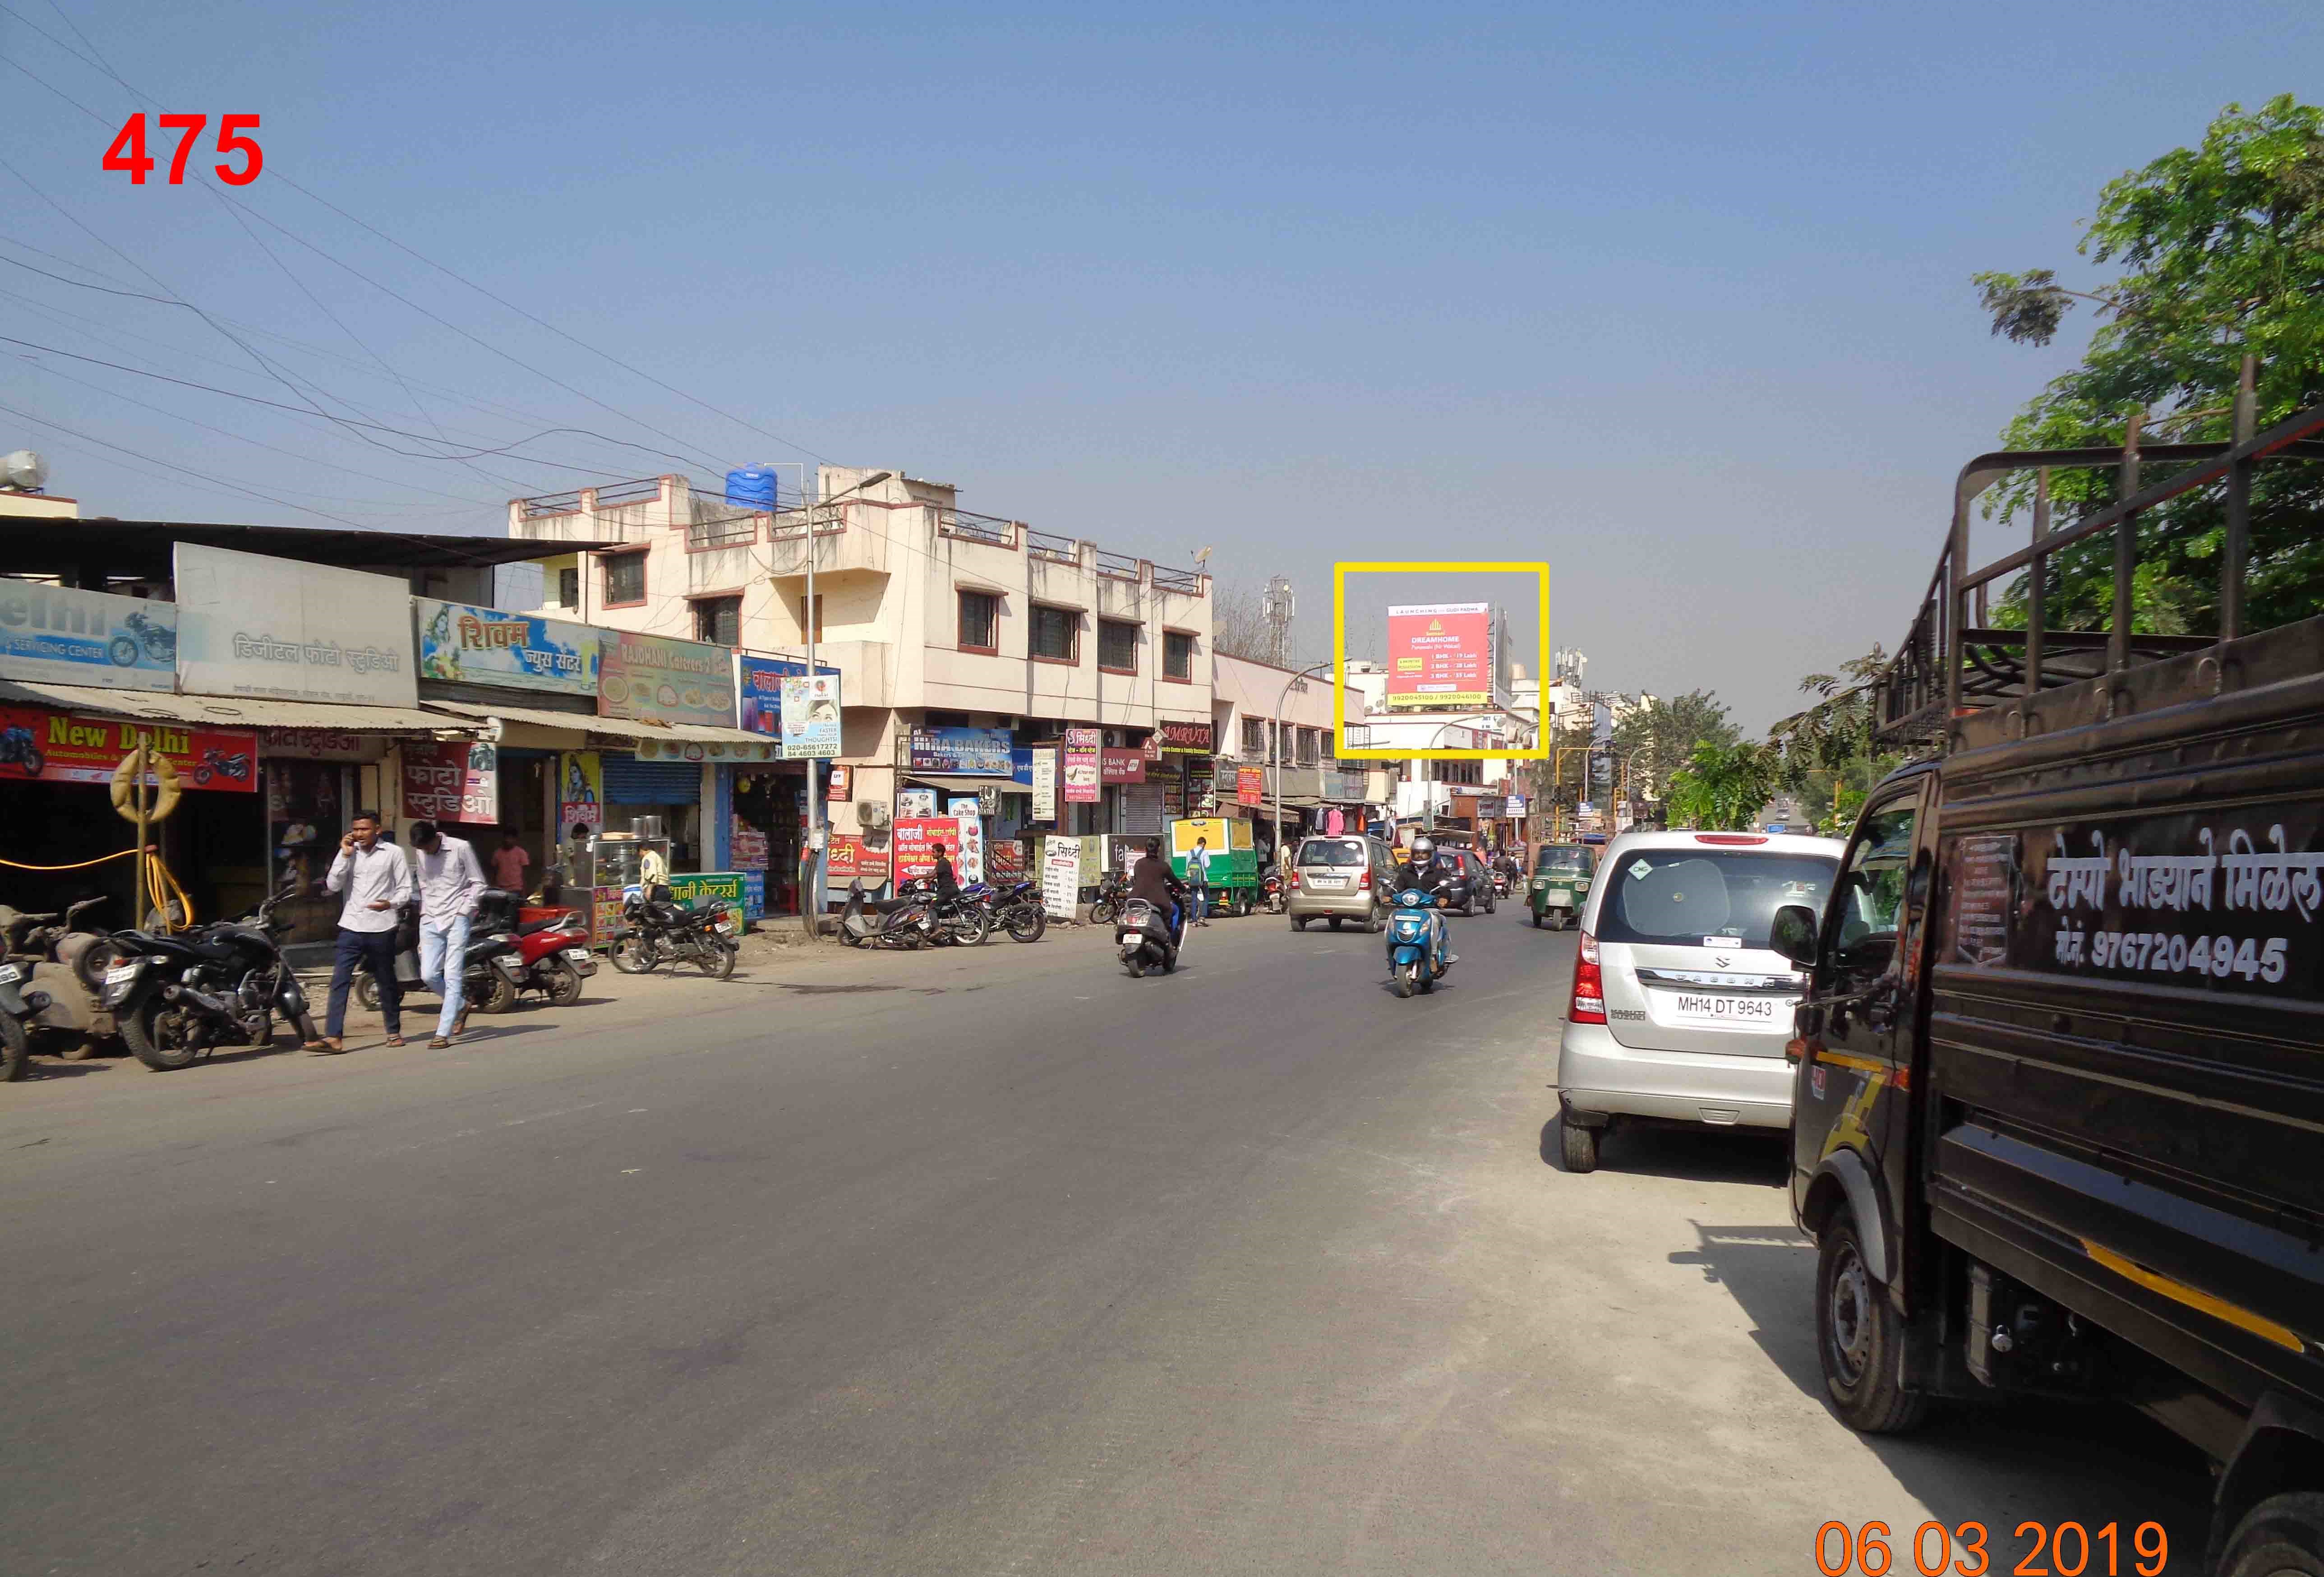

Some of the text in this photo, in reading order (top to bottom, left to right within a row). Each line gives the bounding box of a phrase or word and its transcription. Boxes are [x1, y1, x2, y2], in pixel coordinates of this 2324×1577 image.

[457, 615, 530, 650] शिवम
[68, 644, 103, 658] CENTER
[233, 632, 400, 674] डिजीटल फोटो स्टुडिओ
[621, 643, 666, 668] RAJDHANI
[48, 716, 107, 748] New
[1164, 725, 1209, 744] AMRUTA
[953, 739, 1010, 754] BAKERS
[407, 758, 462, 787] फोटो
[1108, 758, 1126, 766] BANK
[406, 786, 493, 819] स्टुडिओ
[896, 823, 923, 841] बालाजी
[828, 842, 855, 864] ध्दी
[1057, 842, 1080, 860] सिध्दी
[2221, 823, 2324, 922] मिळेल
[670, 883, 696, 900] धानी
[2092, 930, 2288, 983] 9767204945
[1678, 996, 1711, 1013] MH14
[1715, 999, 1735, 1014] DT
